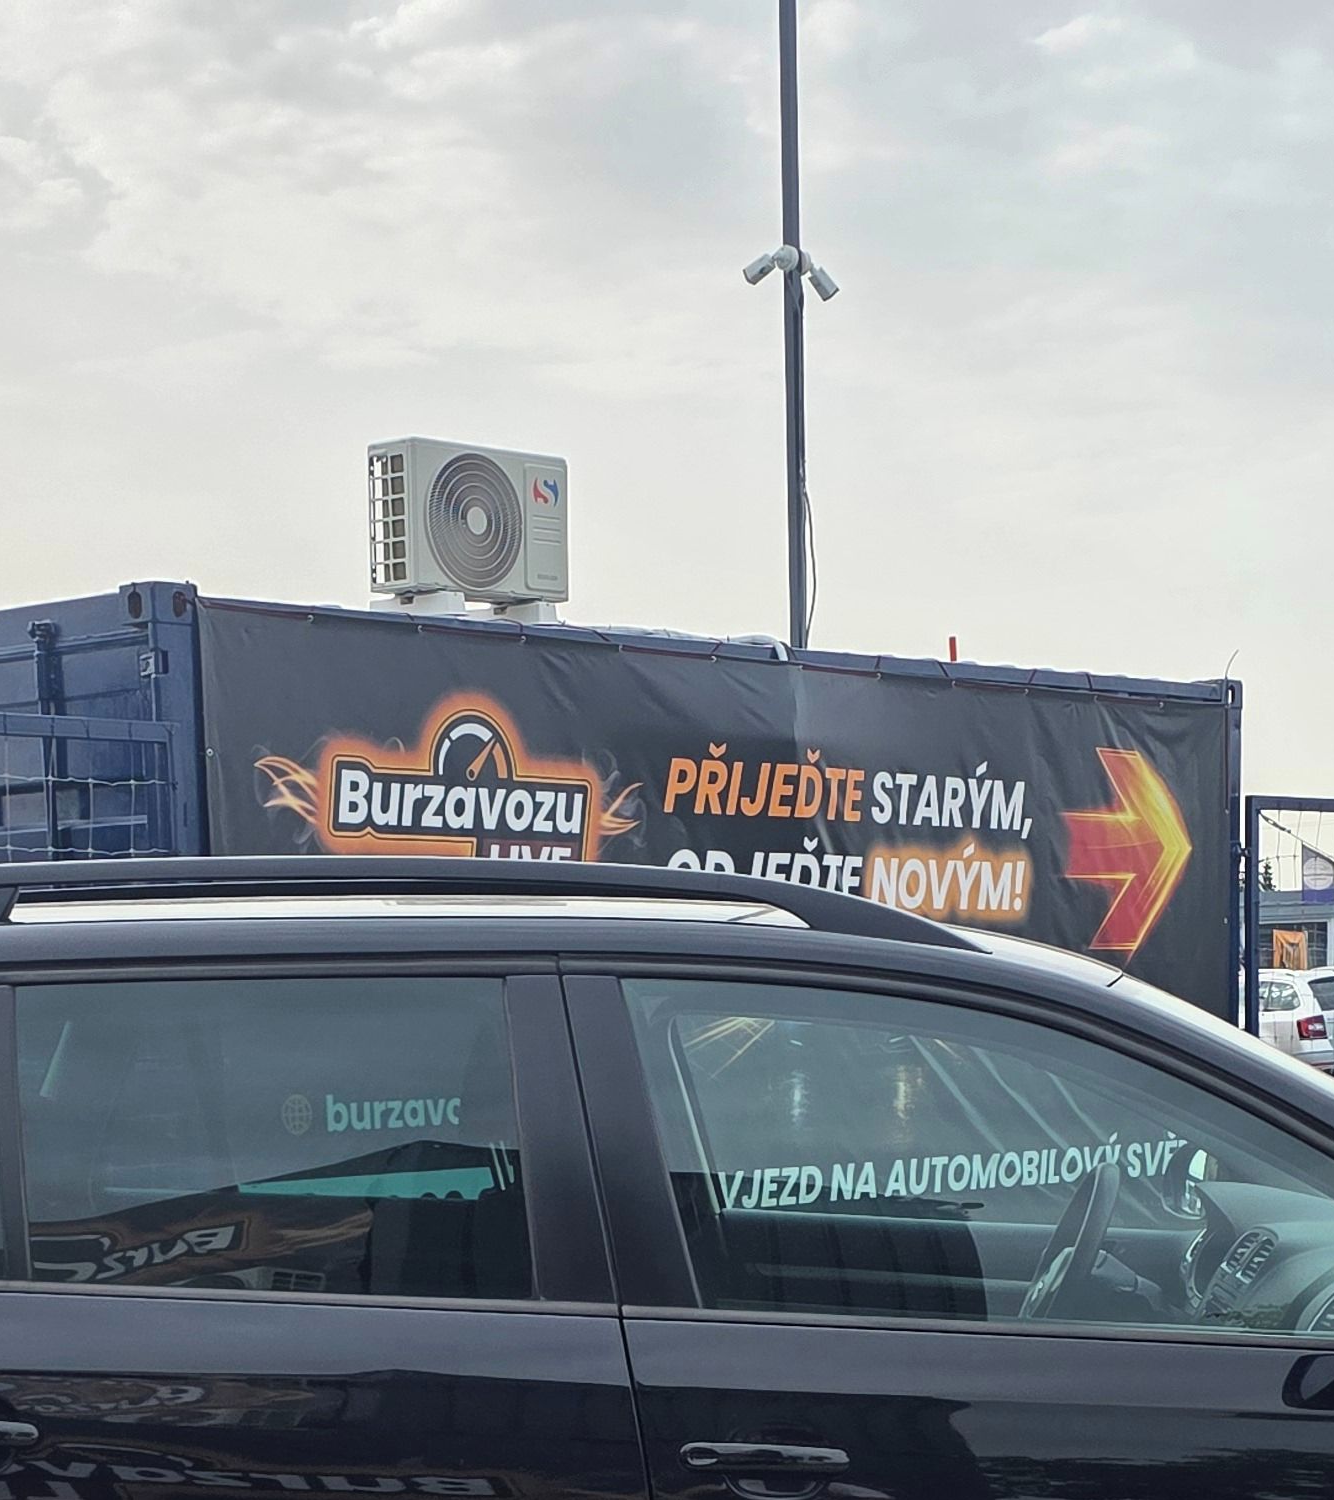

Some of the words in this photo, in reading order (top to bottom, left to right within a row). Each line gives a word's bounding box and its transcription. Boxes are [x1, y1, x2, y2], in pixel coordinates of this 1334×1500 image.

[338, 768, 584, 834] Burzavozu
[663, 742, 865, 821] PŘIJEĎTE
[870, 761, 1033, 839] STARÝM,
[870, 843, 1026, 911] NOVÝM!
[718, 1166, 823, 1209] VJEZD
[830, 1161, 877, 1201] NA
